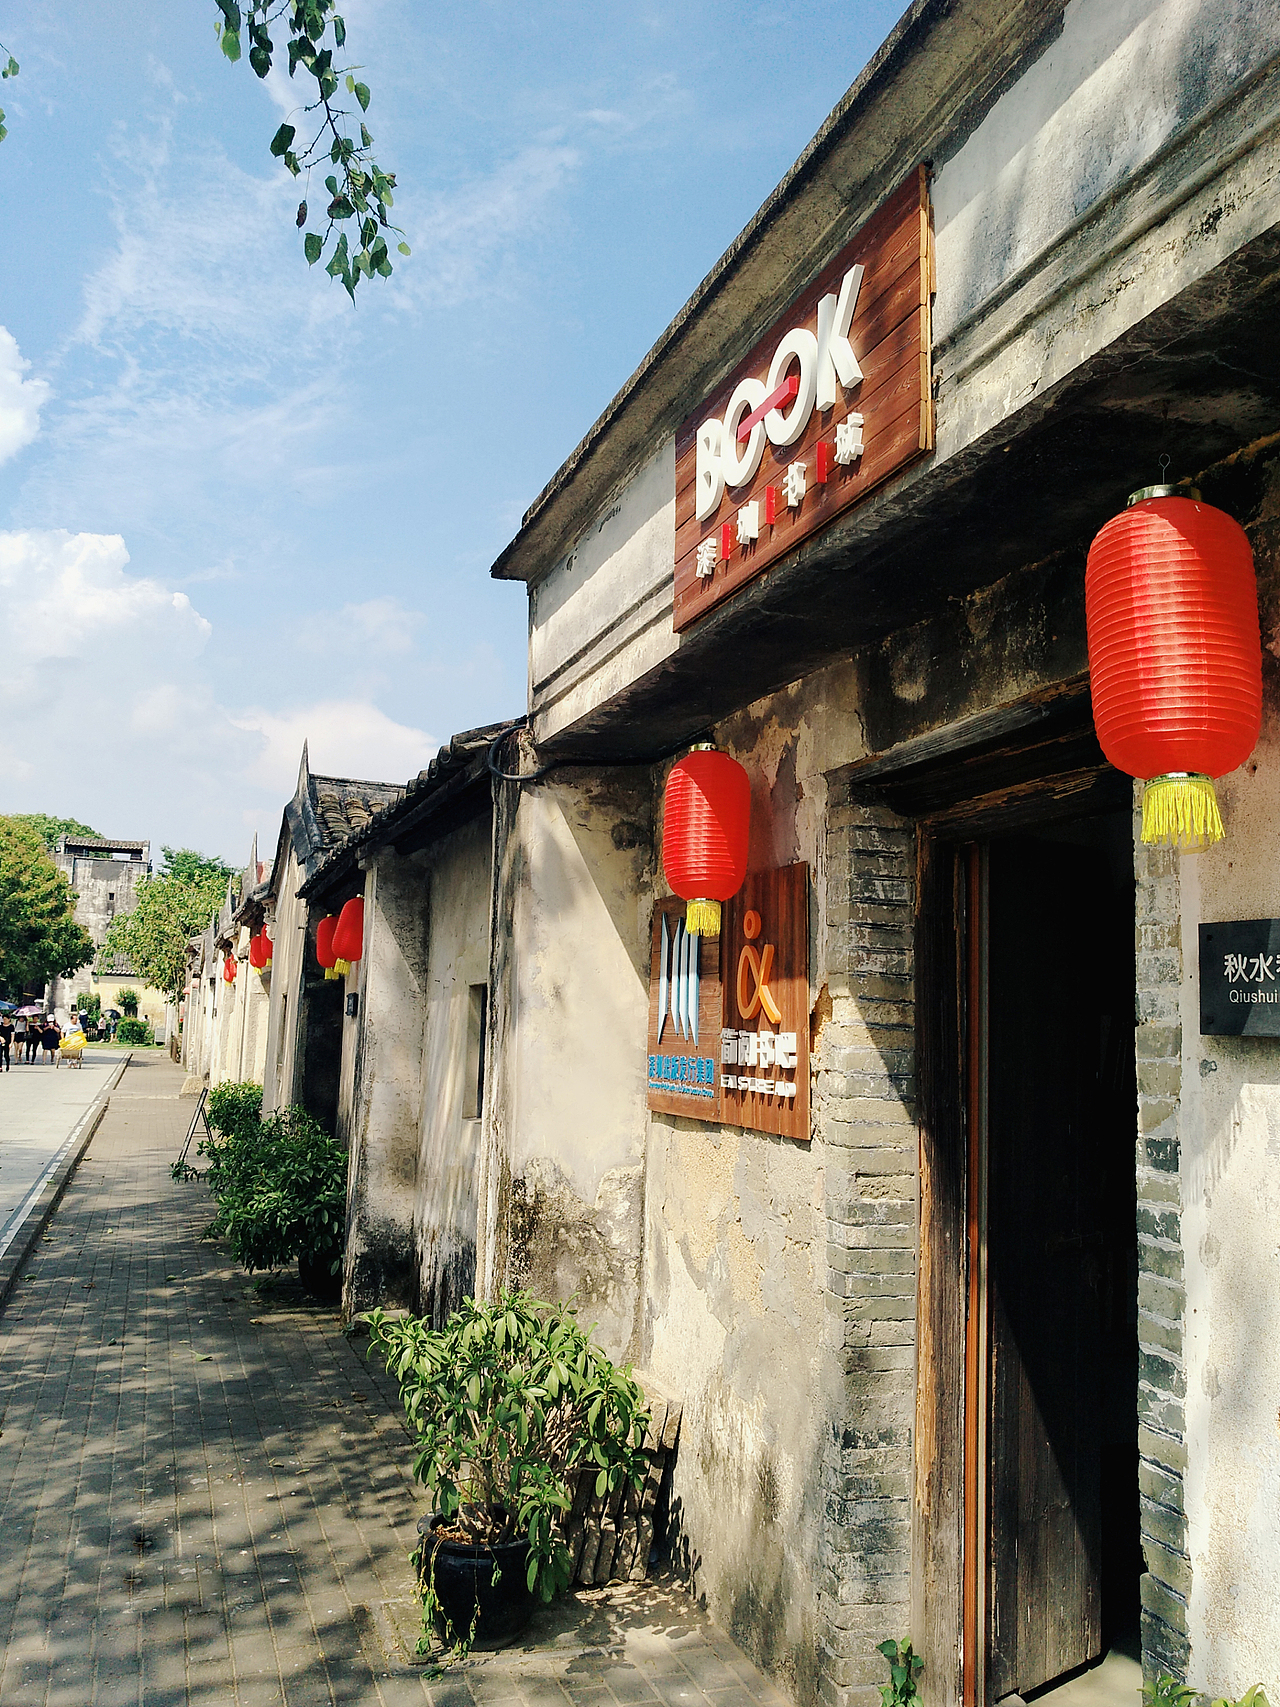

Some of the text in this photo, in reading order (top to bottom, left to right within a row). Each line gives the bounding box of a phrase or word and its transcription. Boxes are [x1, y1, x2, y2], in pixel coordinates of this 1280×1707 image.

[695, 263, 865, 522] BOOK
[1223, 952, 1280, 983] 秋水
[1229, 989, 1279, 1004] Qiushui
[648, 1054, 715, 1085] 深圳出版发行集团
